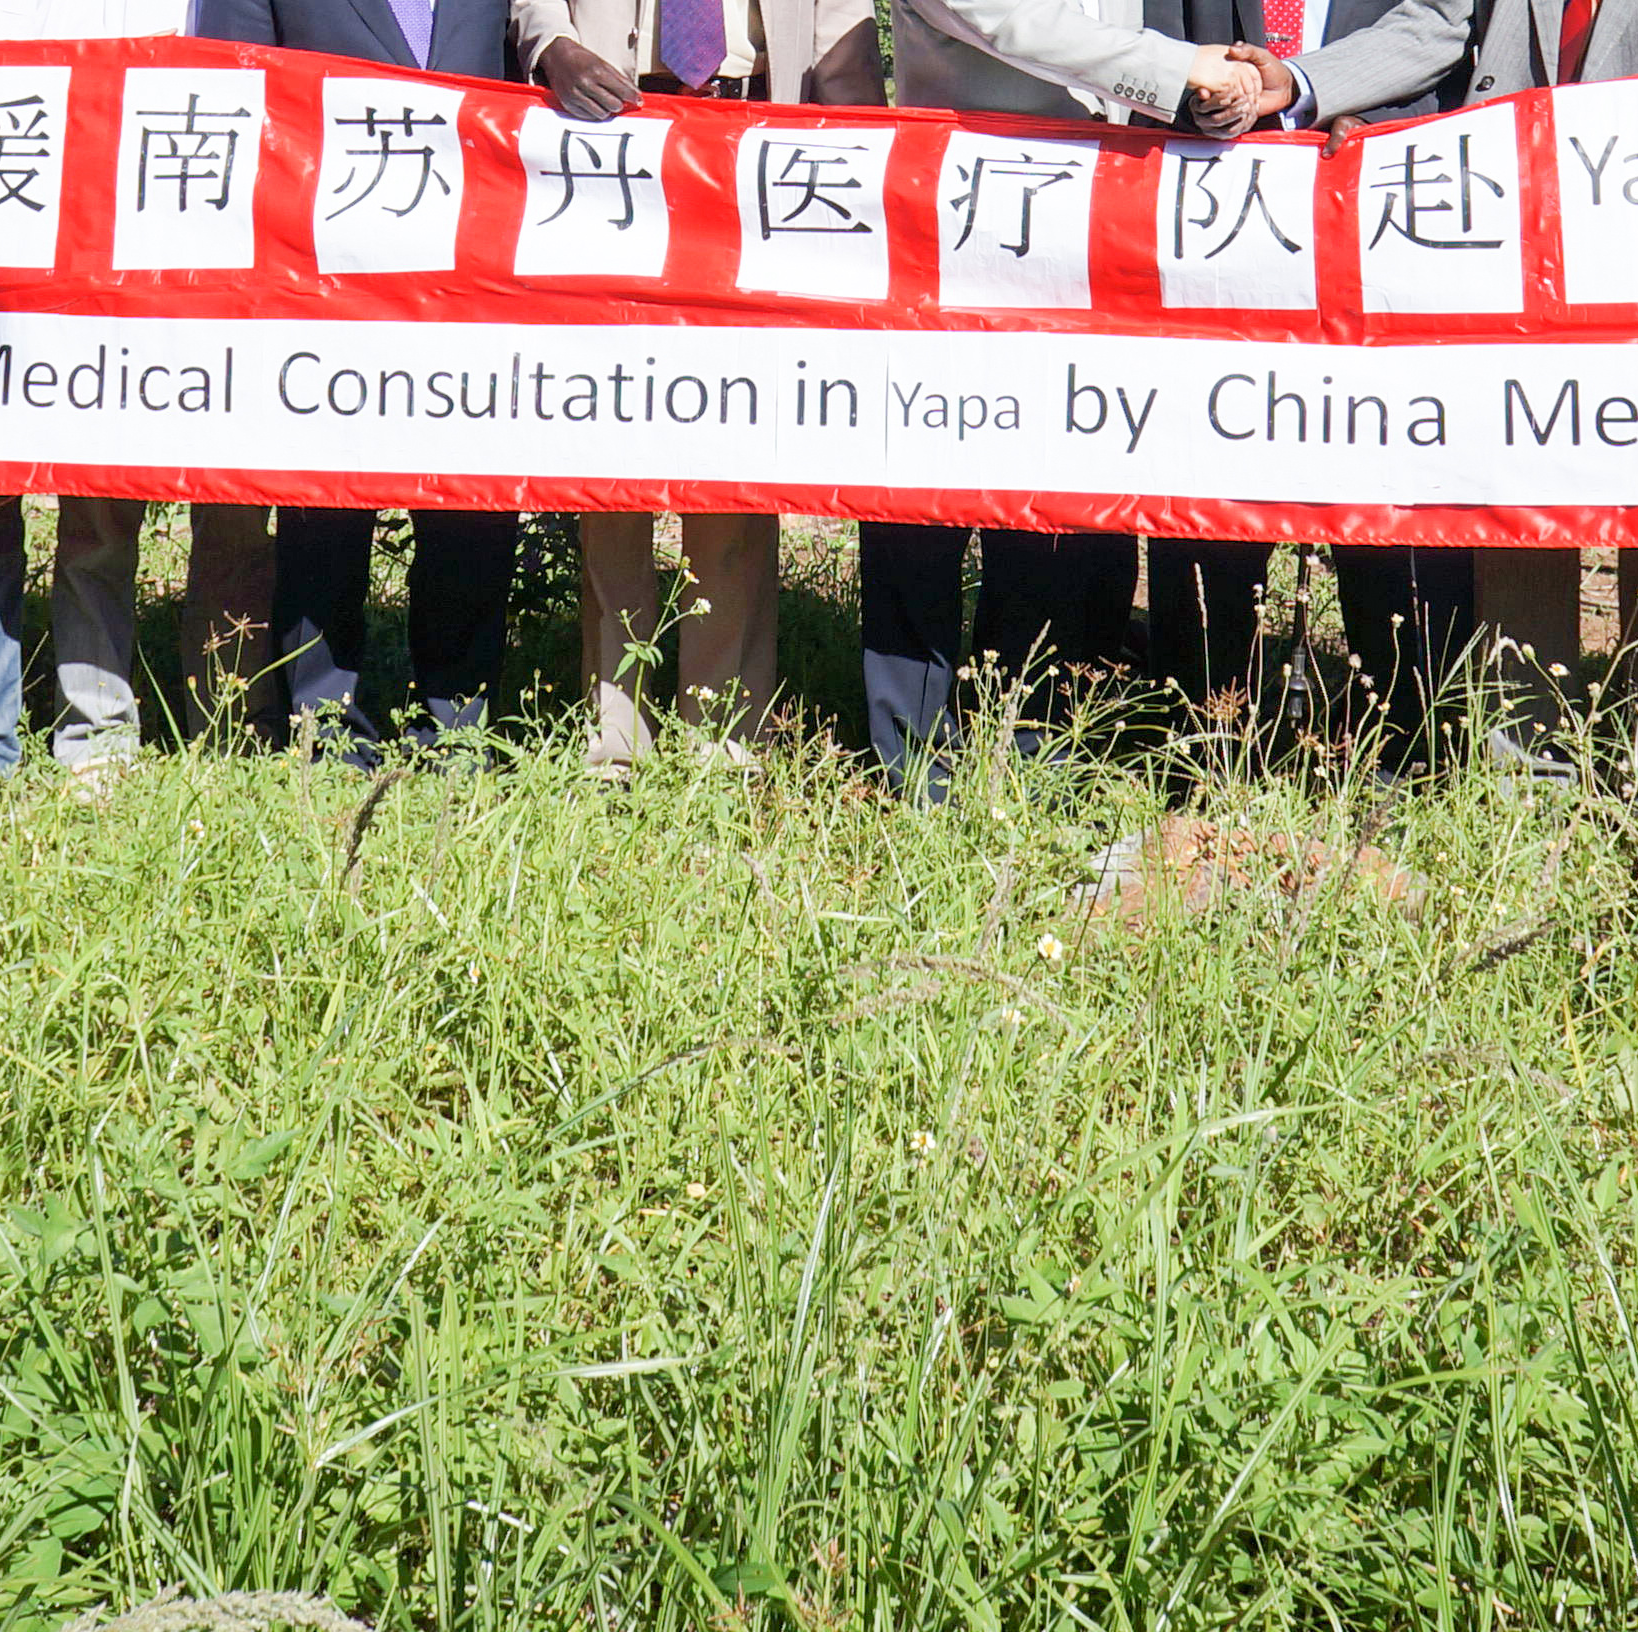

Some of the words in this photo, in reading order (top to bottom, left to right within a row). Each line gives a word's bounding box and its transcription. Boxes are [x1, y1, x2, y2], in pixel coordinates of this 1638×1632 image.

[278, 351, 758, 425] Consultation
[796, 360, 858, 427] in
[892, 381, 1021, 441] Yapa
[1066, 363, 1158, 454] by
[1208, 370, 1446, 446] China
